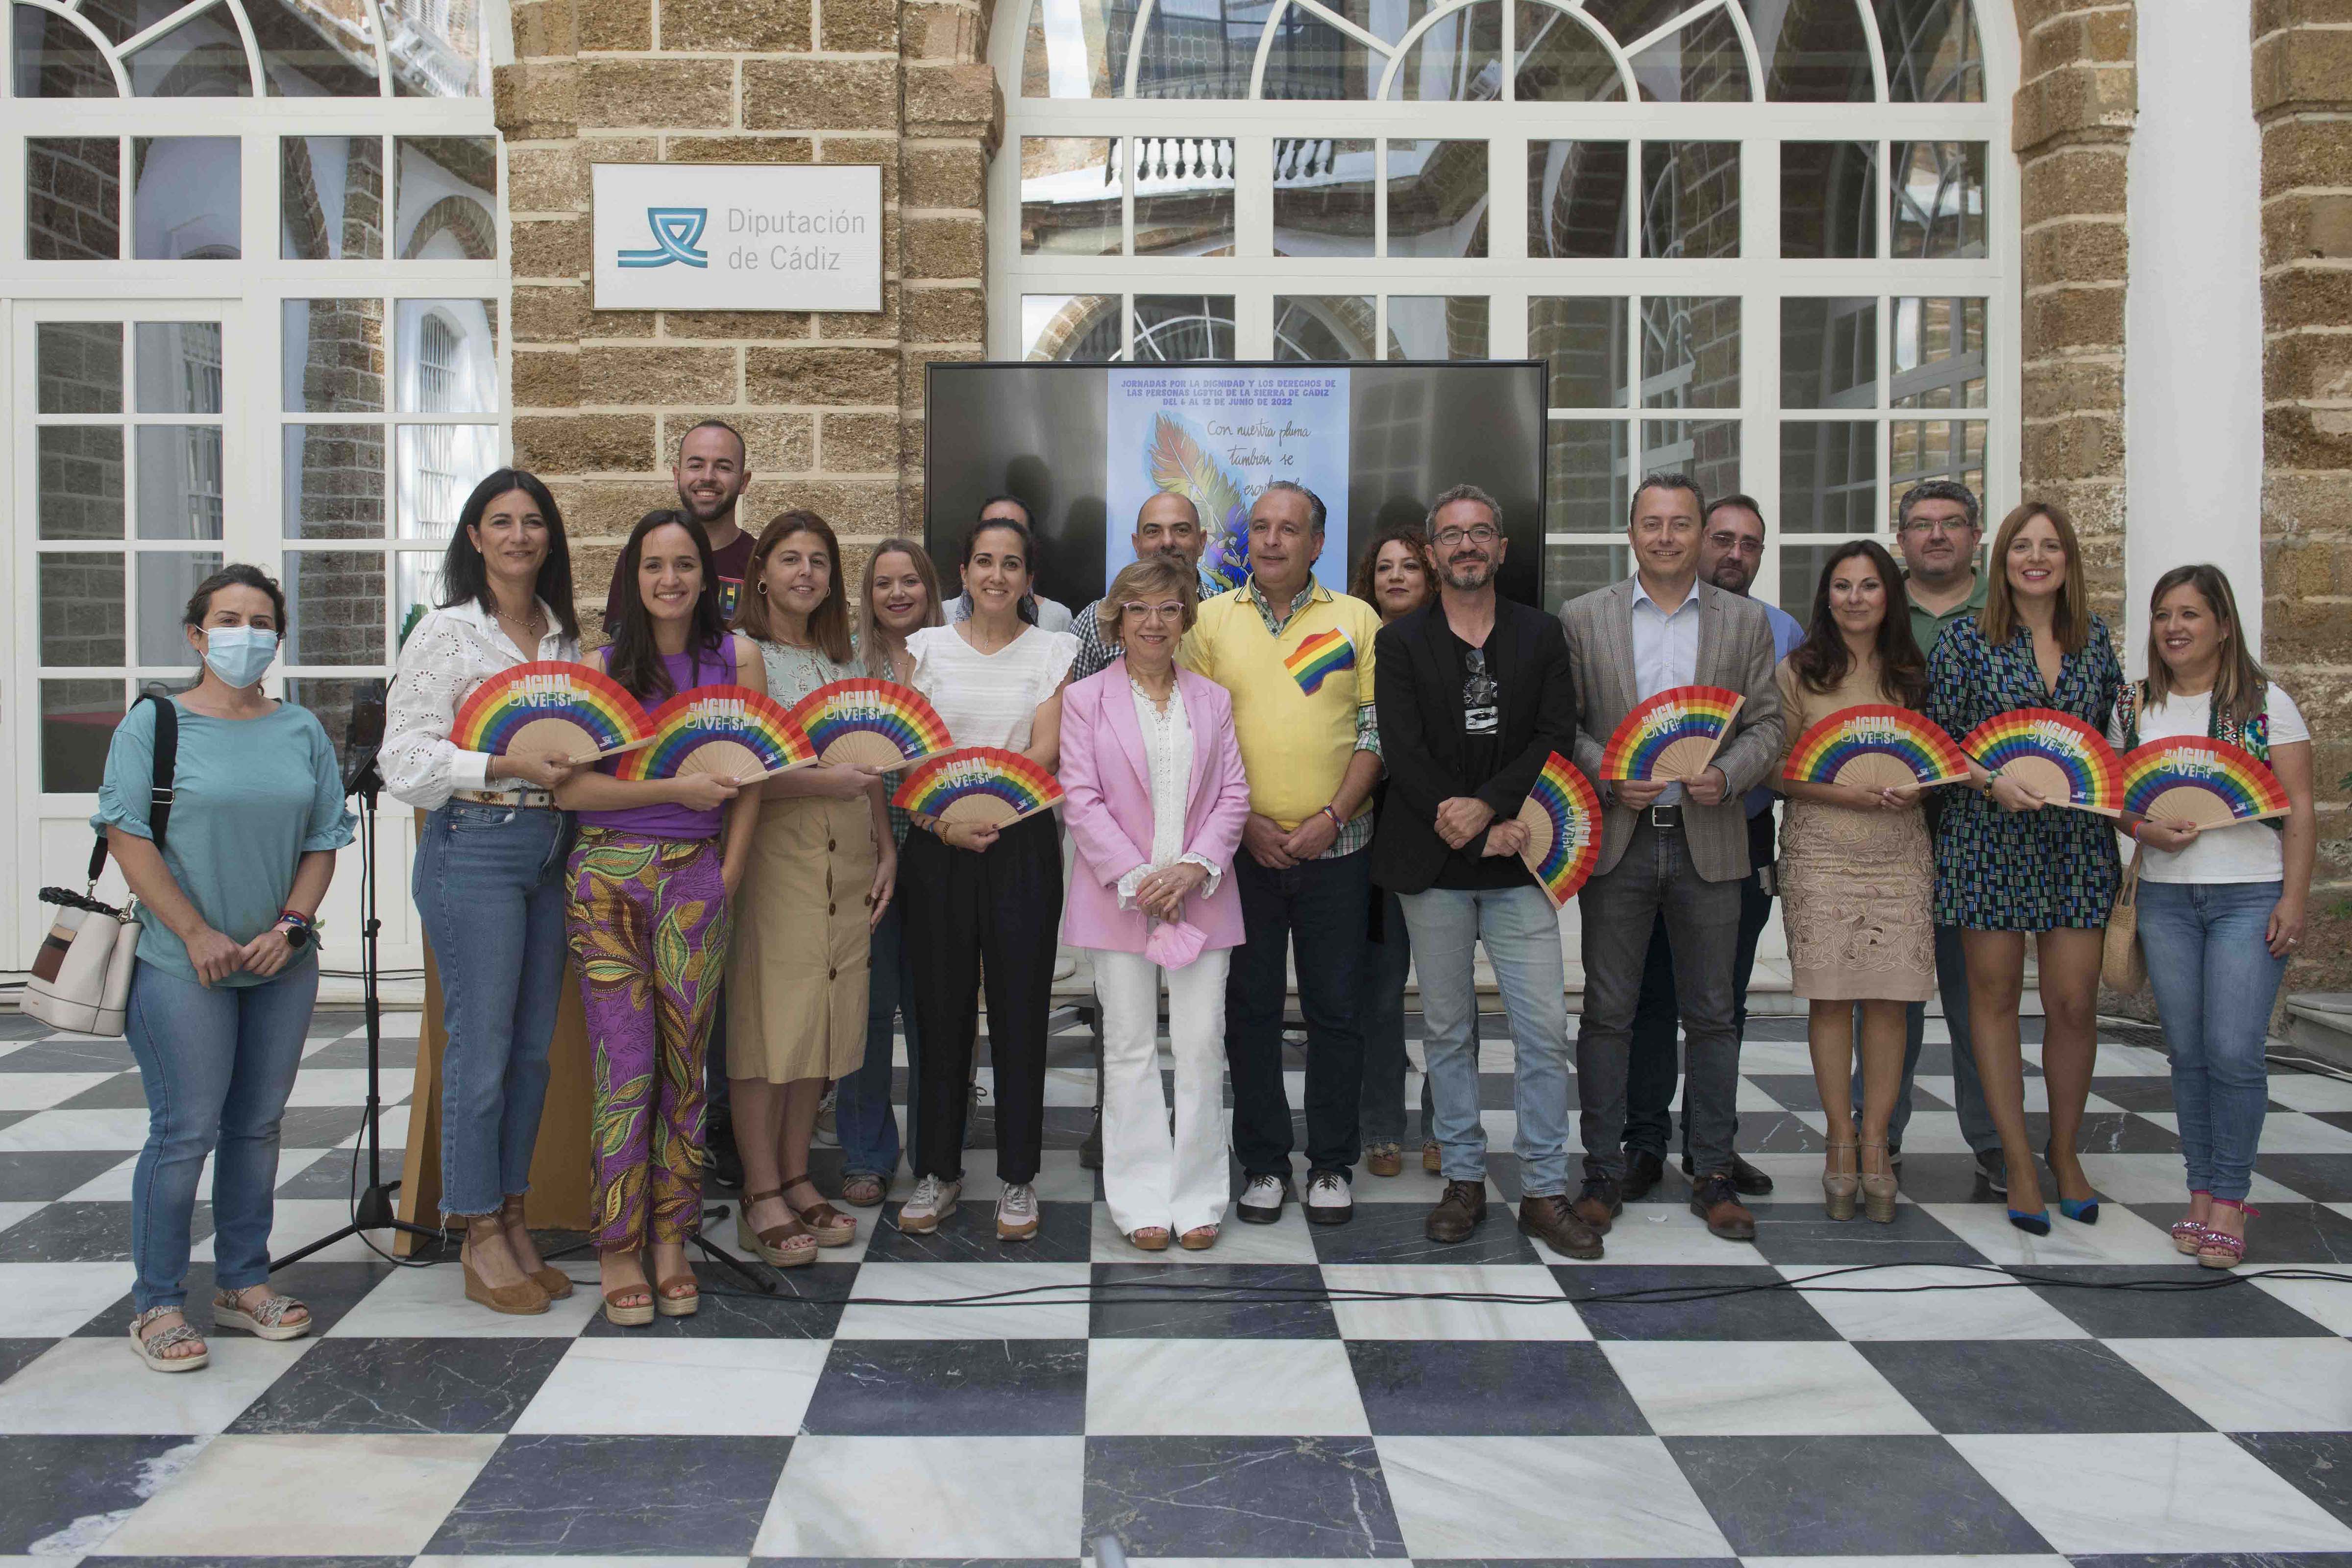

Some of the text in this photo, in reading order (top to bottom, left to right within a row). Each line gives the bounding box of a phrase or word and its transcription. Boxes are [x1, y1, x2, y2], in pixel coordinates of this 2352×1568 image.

[729, 208, 865, 237] Diputación
[729, 245, 841, 270] de Cádiz
[1226, 389, 1237, 397] DE
[1240, 389, 1250, 397] LA
[1253, 389, 1285, 397] SIERRA
[1289, 389, 1299, 397] DE
[1207, 418, 1311, 446] Con nuestra pluma
[1279, 454, 1294, 466] se
